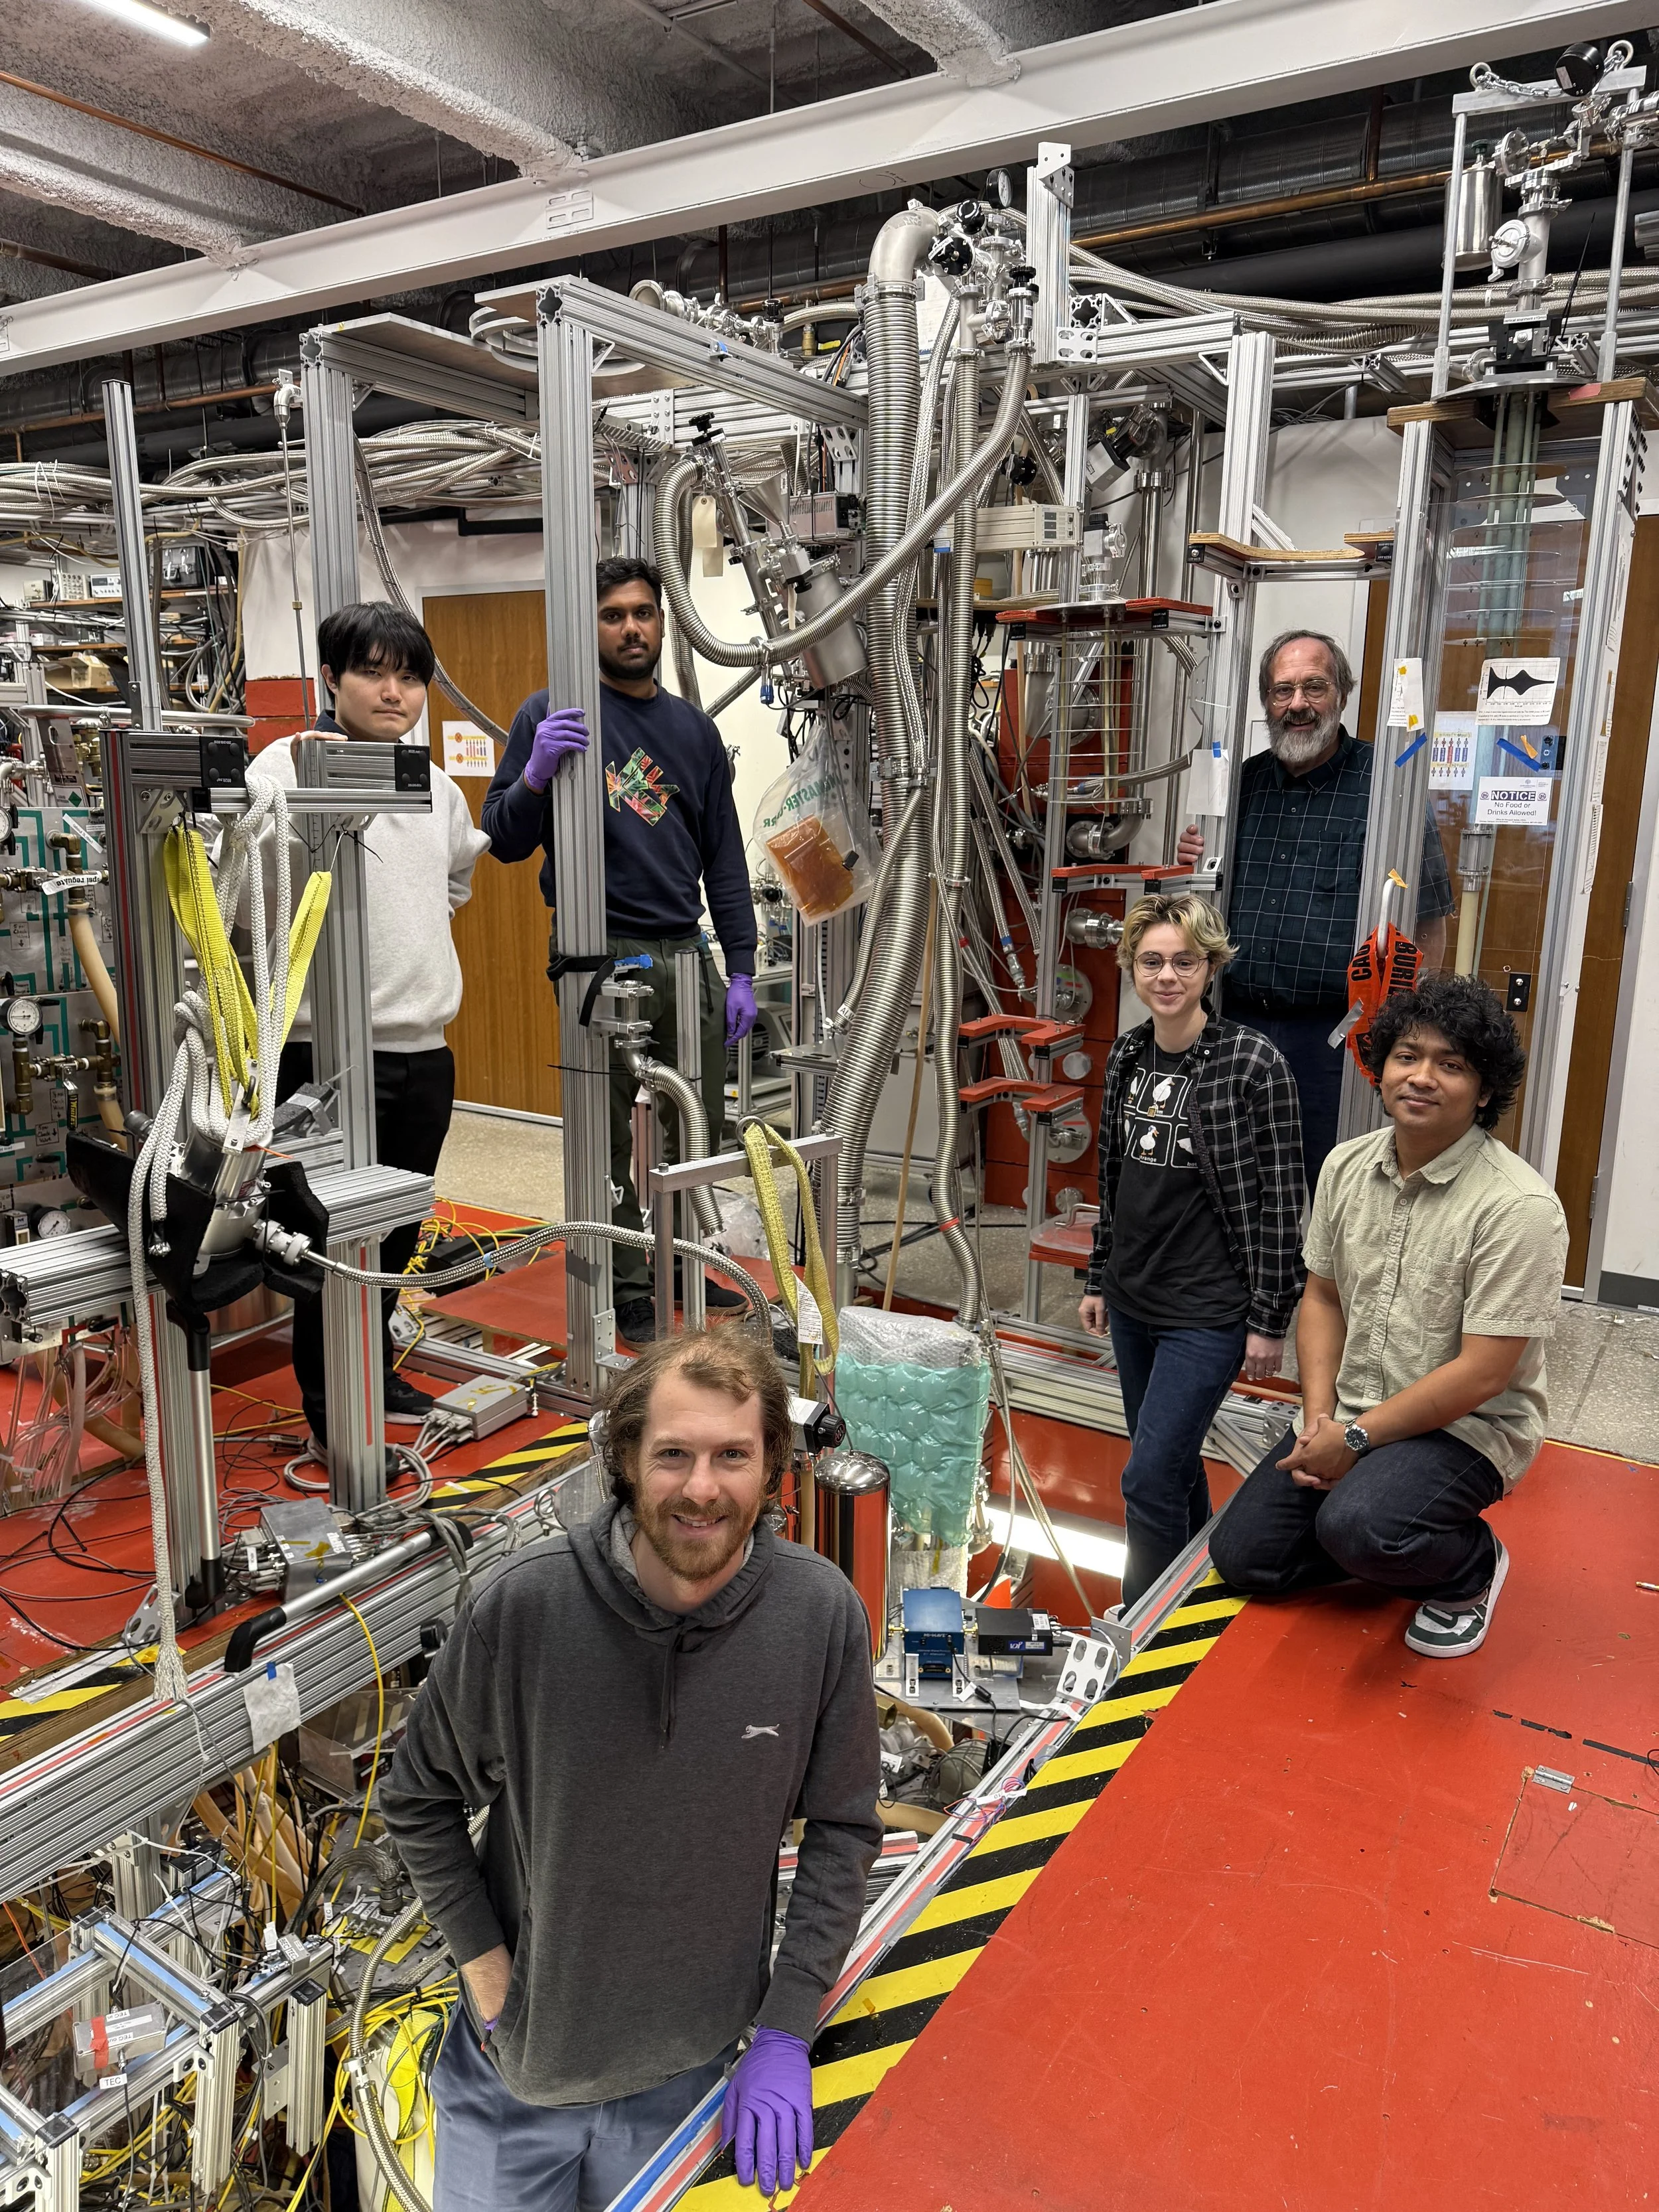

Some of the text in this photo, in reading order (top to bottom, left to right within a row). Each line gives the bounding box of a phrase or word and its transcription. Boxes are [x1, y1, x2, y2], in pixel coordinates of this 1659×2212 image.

[1491, 790, 1536, 800] NOTICE
[1351, 933, 1373, 982] CAU
[279, 1937, 290, 1949] BEC
[288, 1947, 297, 1960] TEC
[105, 2077, 121, 2086] TEC
